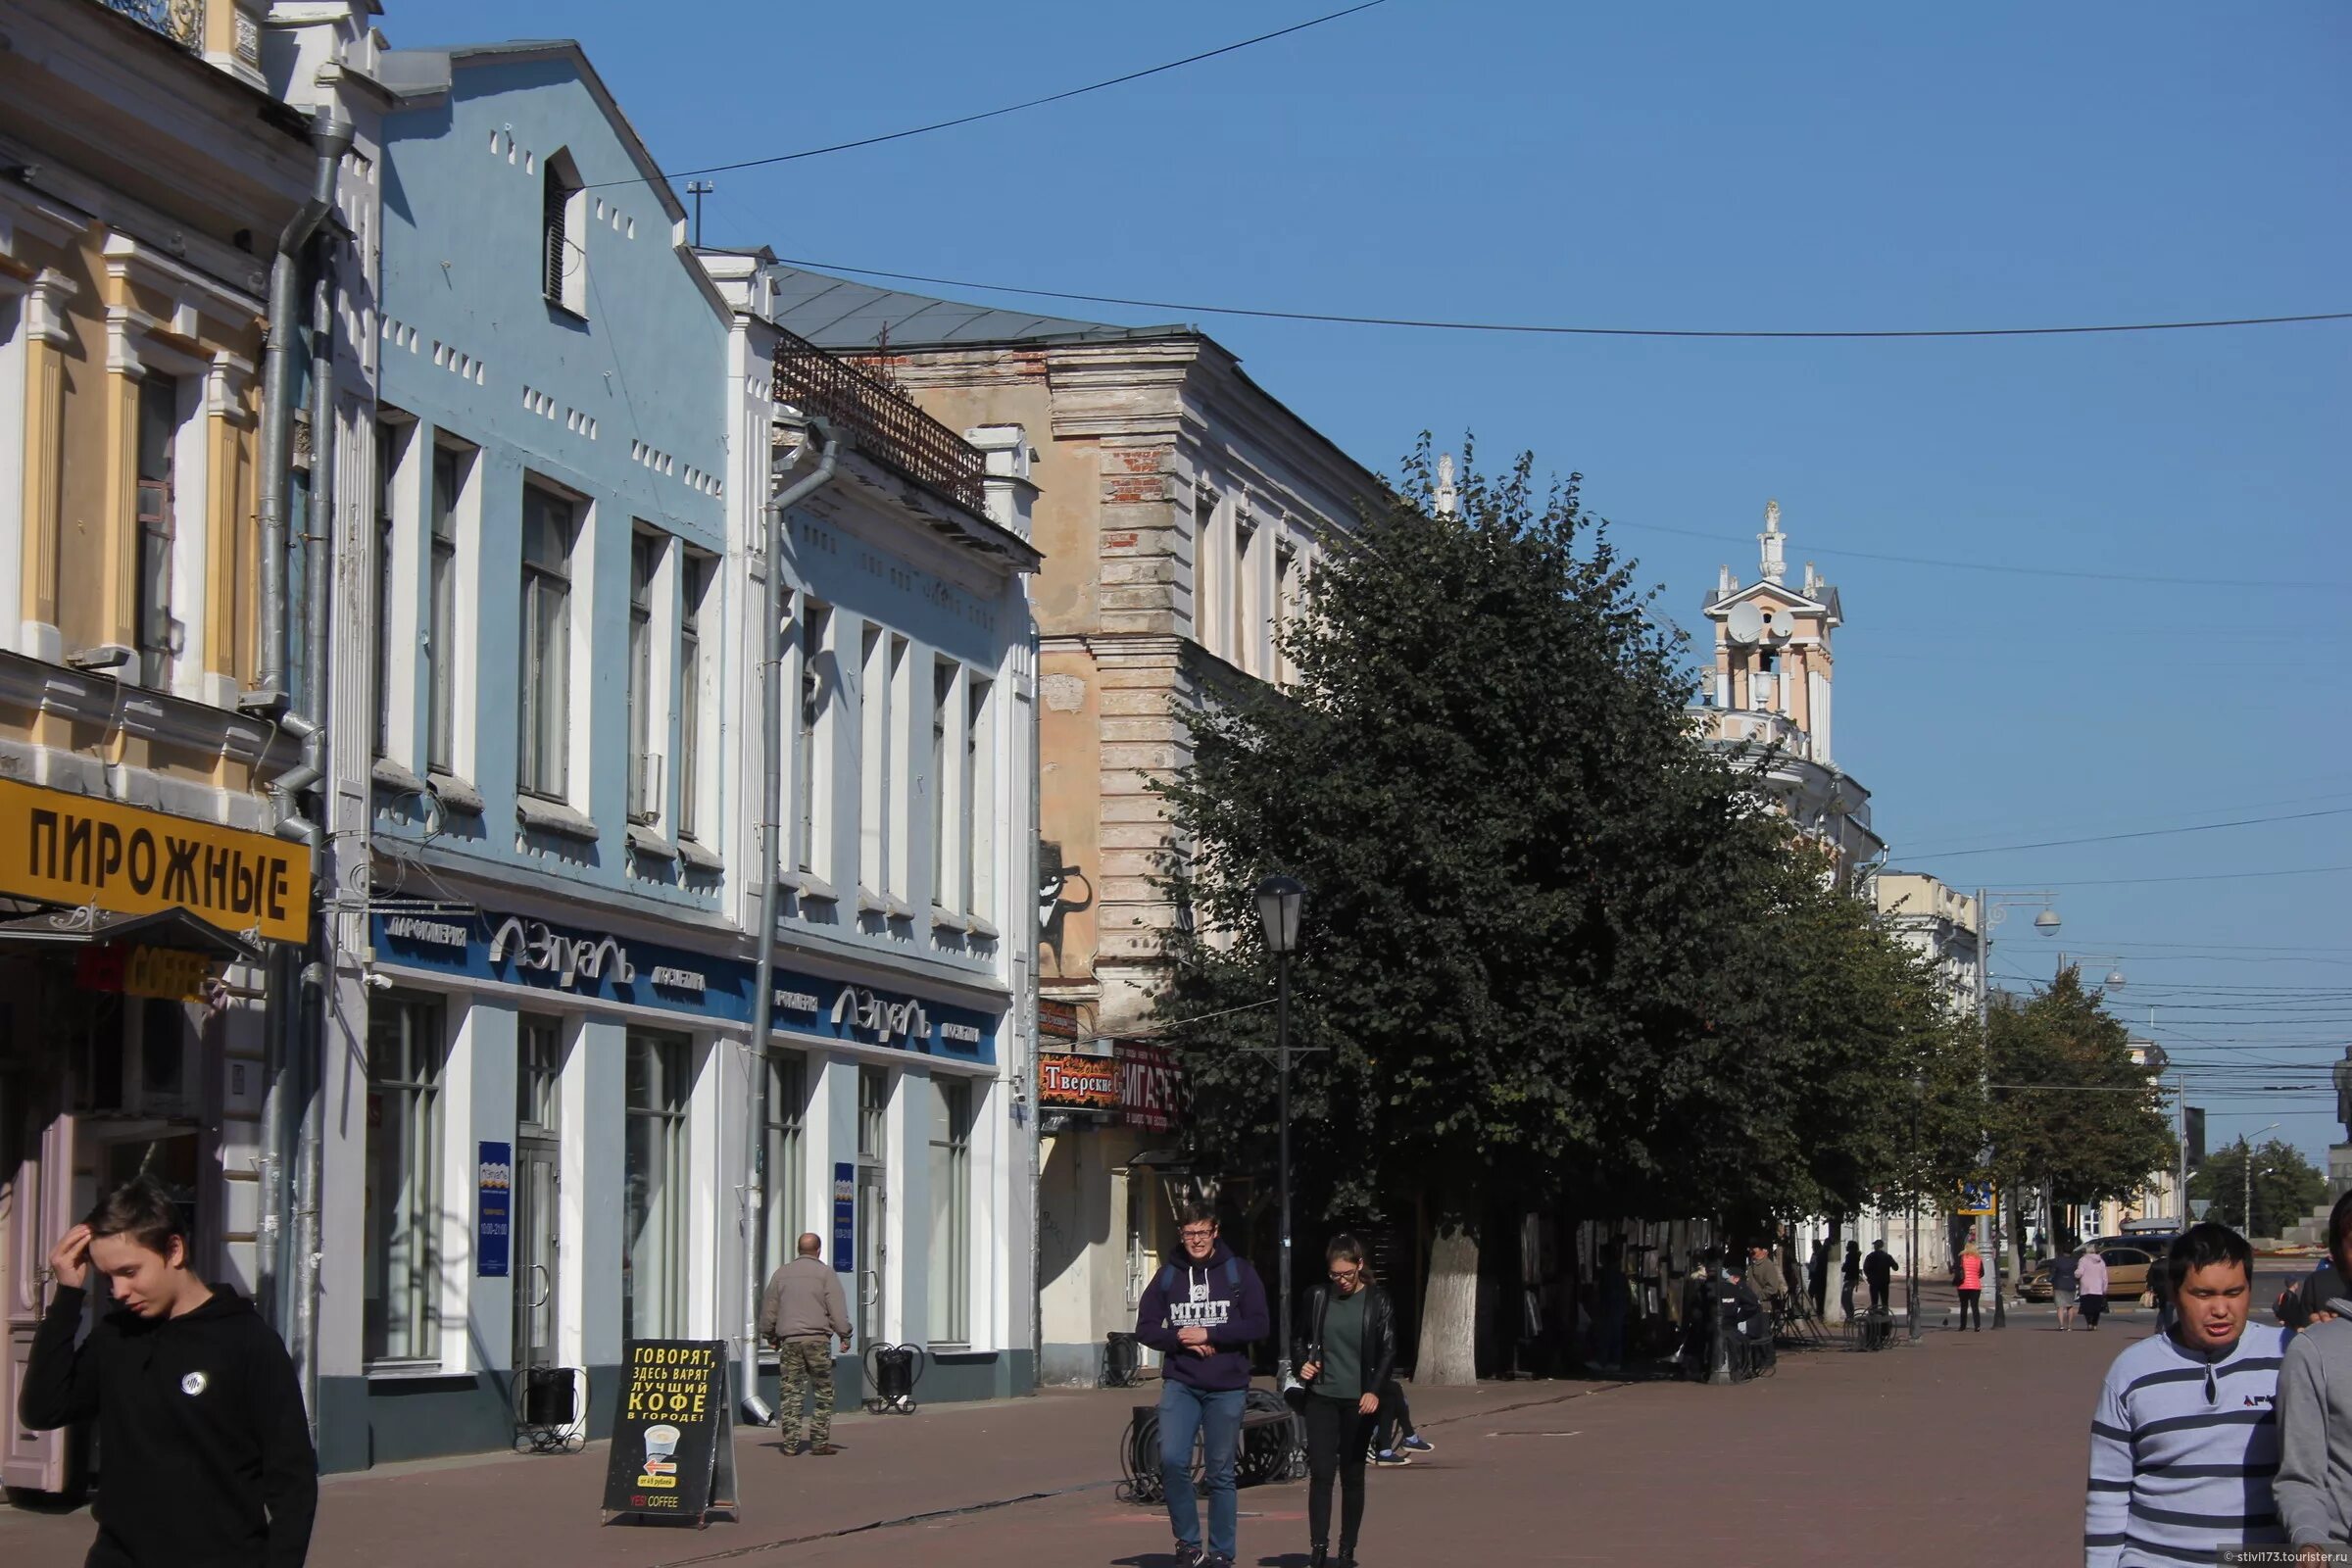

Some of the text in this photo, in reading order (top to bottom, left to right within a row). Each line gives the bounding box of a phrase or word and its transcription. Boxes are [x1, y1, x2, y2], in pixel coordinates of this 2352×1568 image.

[29, 808, 288, 921] ПИРОЖНЫЕ
[1045, 1066, 1112, 1097] Тверские
[1169, 1300, 1231, 1320] MITHT
[634, 1348, 716, 1368] ГОВОРЯТ,
[632, 1367, 710, 1382] ЗДЕСЬ ВАРЯТ
[631, 1381, 708, 1395] ЛУЧШИЙ
[628, 1393, 706, 1413] КОФЕ
[642, 1412, 704, 1422] ГОРОДЕ!
[648, 1495, 678, 1508] COFFEE
